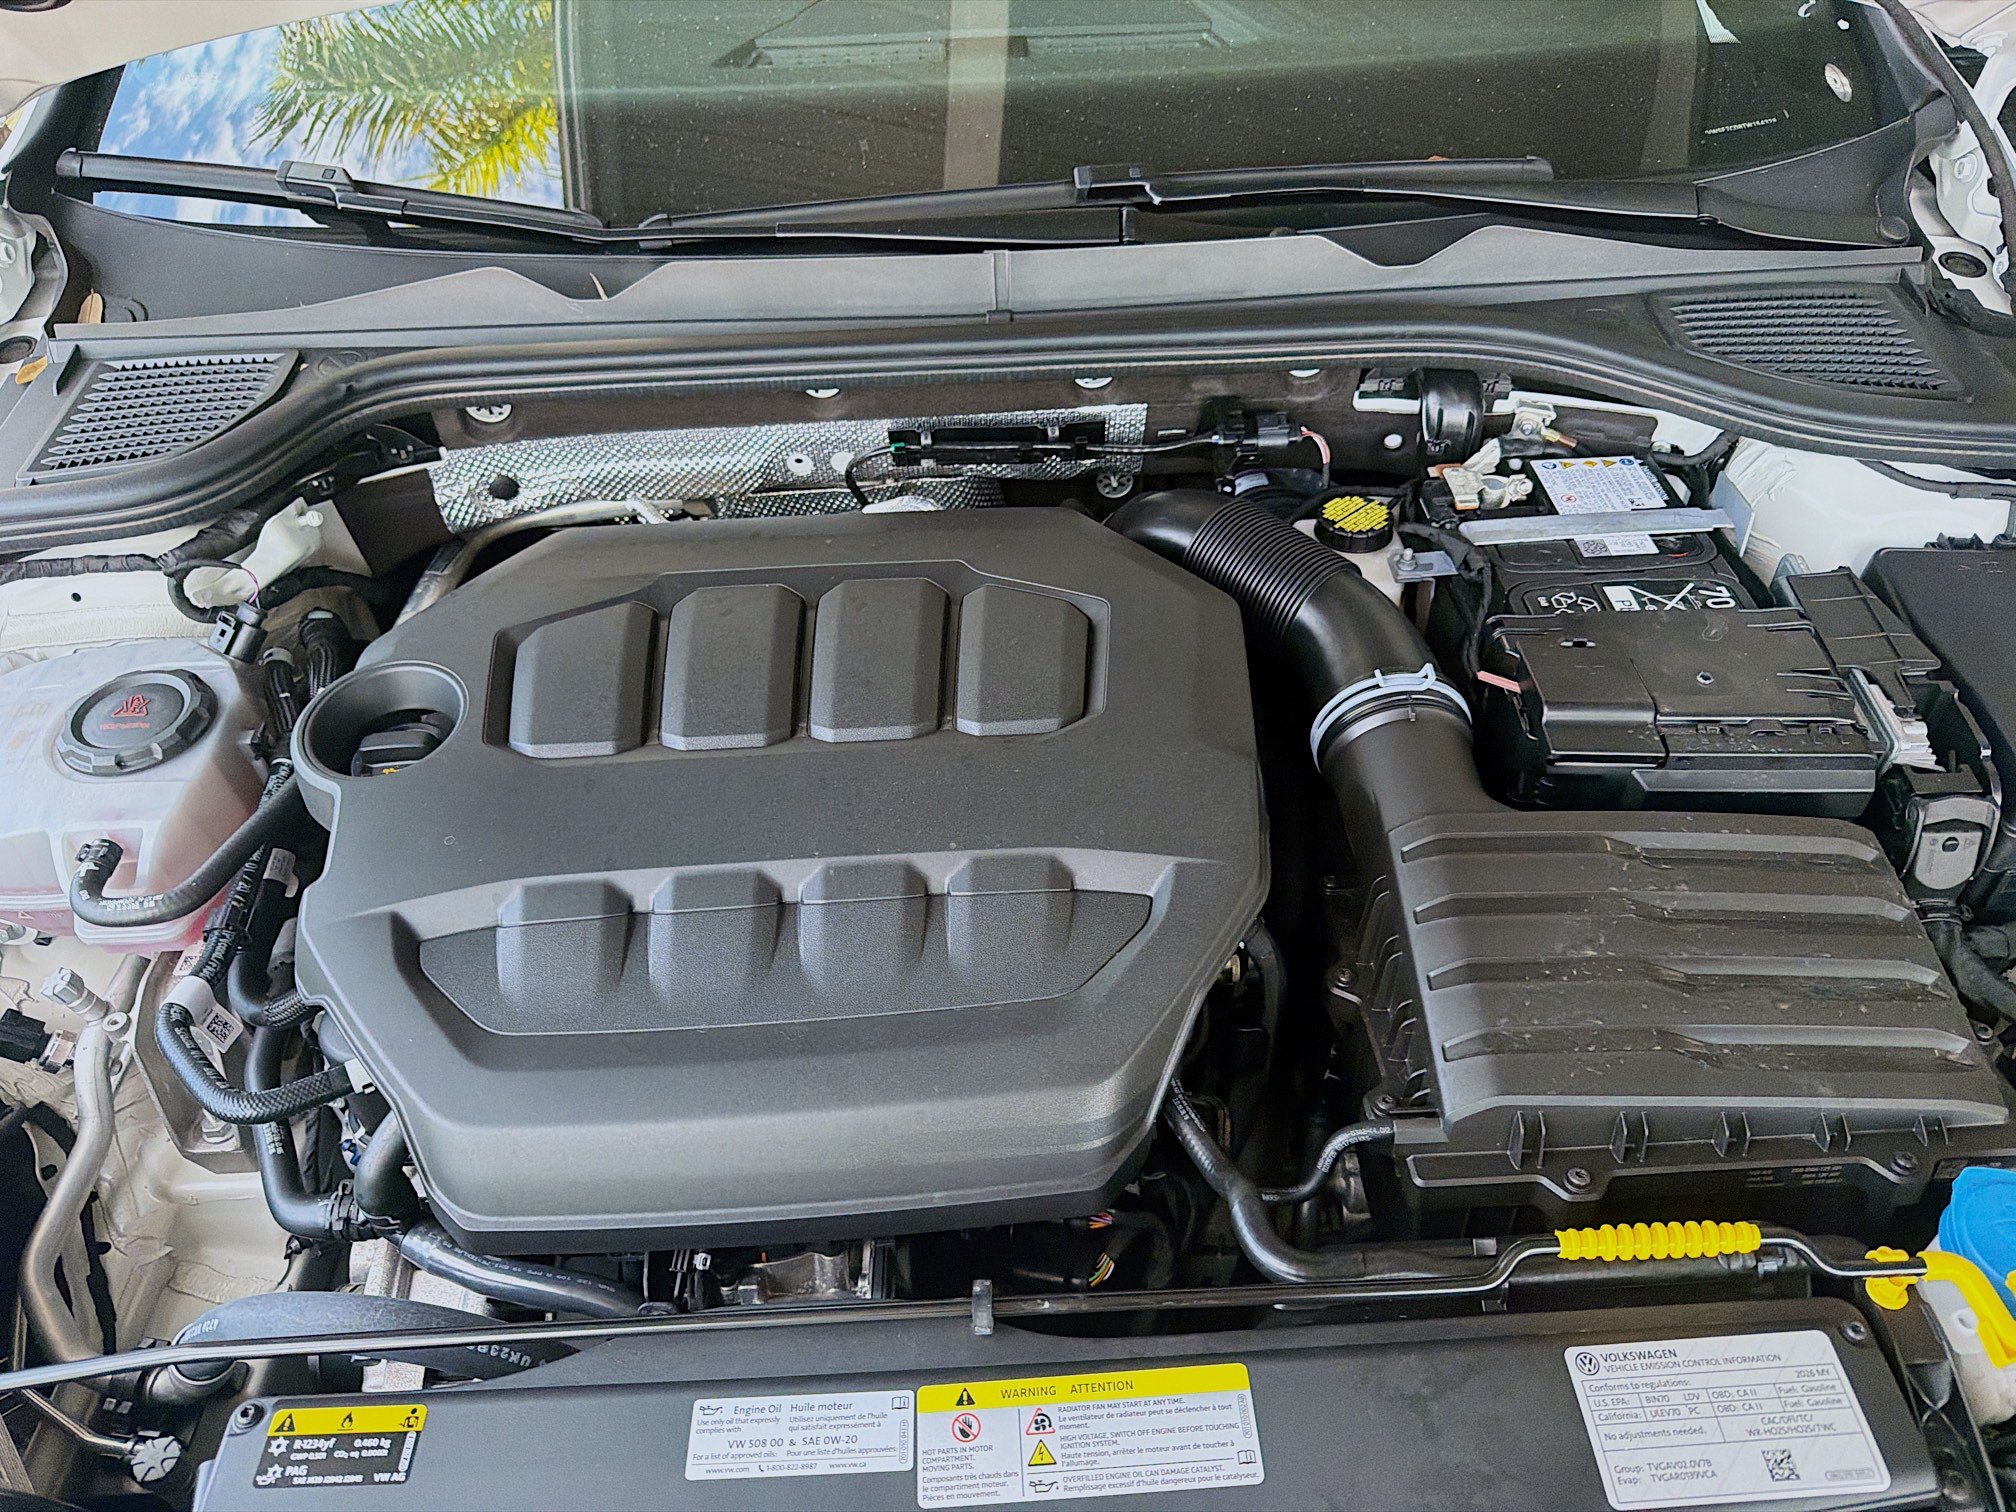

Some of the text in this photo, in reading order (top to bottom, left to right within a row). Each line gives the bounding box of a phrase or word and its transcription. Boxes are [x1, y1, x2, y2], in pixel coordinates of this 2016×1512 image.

[1698, 586, 1736, 609] 70
[1600, 1349, 1678, 1363] VOLKSWAGEN
[1604, 1354, 1781, 1373] VEHICLE EMISSION CONTROL INFORMATION
[1000, 1380, 1134, 1399] WARNING ATTENTION
[1589, 1383, 1629, 1393] Conforms
[1630, 1382, 1641, 1390] to
[734, 1404, 782, 1416] Engine Oil
[790, 1402, 853, 1412] Huile moteur
[1057, 1404, 1091, 1413] RADIATOR
[1122, 1400, 1143, 1408] START
[789, 1415, 814, 1423] Utilisez
[815, 1414, 856, 1422] uniquement
[1067, 1412, 1105, 1421] ventilateur
[1116, 1410, 1147, 1418] radiateur
[1148, 1408, 1164, 1417] peut
[1174, 1405, 1211, 1413] déclencher
[711, 1418, 724, 1426] only
[750, 1416, 780, 1425] expressly
[788, 1424, 800, 1432] qui
[801, 1422, 827, 1430] satisfait
[696, 1427, 725, 1435] complies
[1060, 1434, 1077, 1442] HIGH
[1110, 1430, 1136, 1438] SWITCH
[1151, 1427, 1176, 1435] ENGINE
[1178, 1425, 1204, 1433] BEFORE
[1205, 1422, 1240, 1431] TOUCHING
[1604, 1432, 1617, 1441] No
[1618, 1428, 1671, 1441] adjustments
[728, 1434, 859, 1449] VW 508 00 & SAE 0W-20
[1060, 1441, 1091, 1450] IGNITION
[1137, 1446, 1144, 1454] le
[1145, 1445, 1170, 1453] moteur
[1202, 1441, 1228, 1449] toucher
[722, 1452, 729, 1460] of
[731, 1451, 762, 1461] approved
[922, 1444, 993, 1456] HOT PARTS IN MOTOR
[285, 1465, 308, 1477] PAG
[922, 1465, 950, 1473] MOVING
[1063, 1474, 1104, 1483] OVERFILLED
[1106, 1471, 1131, 1479] ENGINE
[1132, 1470, 1144, 1478] OIL
[1160, 1466, 1189, 1475] DAMAGE
[373, 1472, 391, 1482] VW
[391, 1472, 407, 1482] AG
[922, 1474, 964, 1485] Composants
[979, 1471, 1002, 1480] chauds
[1003, 1470, 1019, 1478] dans
[922, 1485, 928, 1493] le
[930, 1482, 980, 1493] compartiment
[1063, 1483, 1107, 1493] Remplissage
[1108, 1480, 1135, 1488] excessif
[1160, 1477, 1197, 1486] dangereux
[1198, 1475, 1213, 1483] pour
[923, 1492, 944, 1502] Pièces
